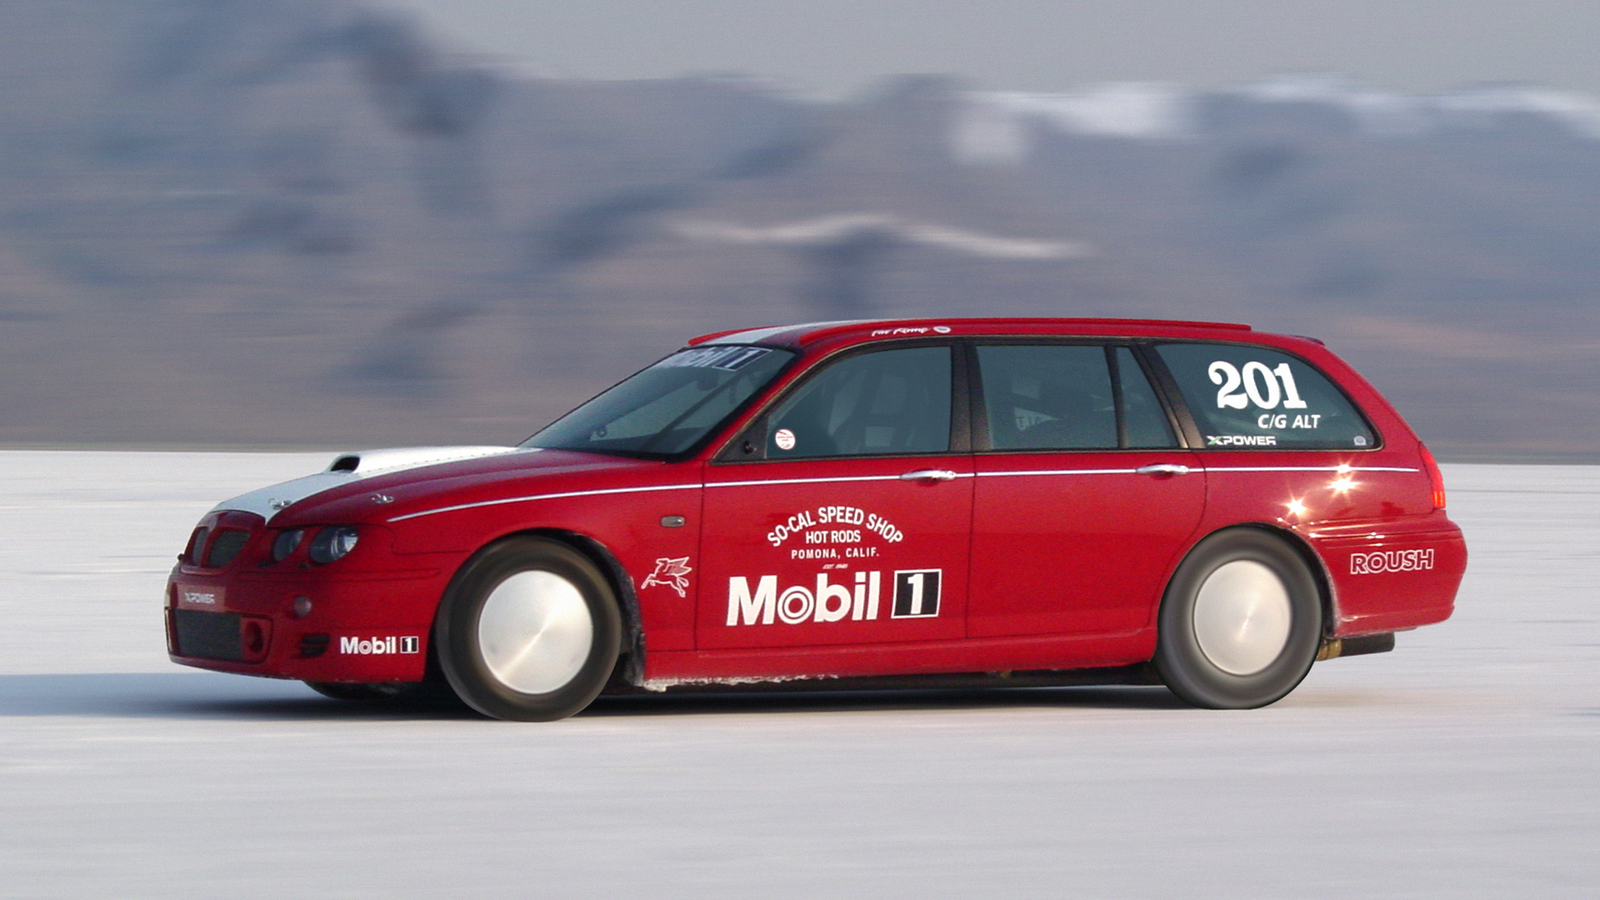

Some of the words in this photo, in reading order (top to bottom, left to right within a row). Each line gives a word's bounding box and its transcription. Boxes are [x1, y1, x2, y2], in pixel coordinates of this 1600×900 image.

[1208, 361, 1307, 409] 201
[1257, 414, 1287, 429] C/G
[1291, 414, 1321, 429] ALT
[1206, 435, 1277, 446] XPOWER
[767, 510, 816, 547] SO-CAL
[818, 506, 864, 525] SPEED
[866, 513, 904, 544] SHOP
[806, 531, 829, 544] HOT
[831, 530, 861, 543] RODS
[791, 549, 841, 560] POMONA,
[846, 547, 880, 558] CALIF.
[1350, 548, 1434, 575] ROUSH
[725, 571, 881, 626] Mobil
[340, 636, 396, 655] Mobil
